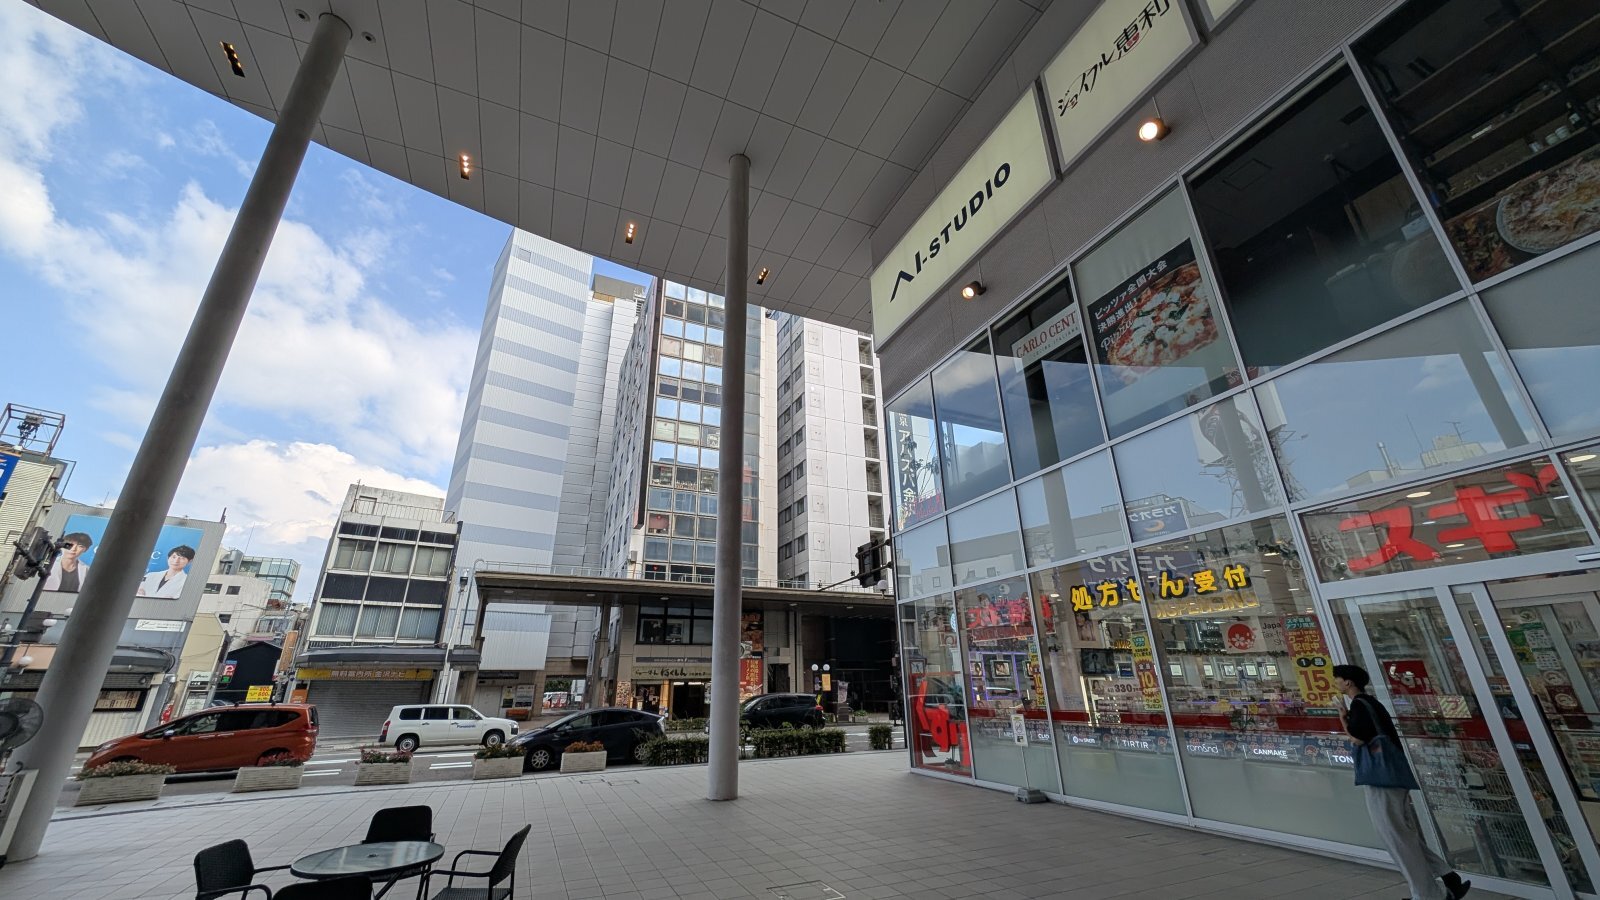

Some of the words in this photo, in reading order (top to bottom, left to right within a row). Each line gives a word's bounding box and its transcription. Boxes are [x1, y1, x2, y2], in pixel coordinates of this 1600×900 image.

[1058, 0, 1170, 117] ジョイフル恵利
[890, 162, 1011, 303] AI-STUDIO
[1095, 260, 1168, 320] ピッツァ全国大会
[1016, 331, 1047, 358] CARLO
[1048, 311, 1076, 338] CENT
[1339, 464, 1558, 571] スギ
[1070, 564, 1248, 612] 処方せん受付
[1289, 635, 1320, 643] クーポン
[1293, 643, 1320, 651] 配信中
[1122, 739, 1149, 749] TIRTIR
[1253, 748, 1287, 757] CANMAKE
